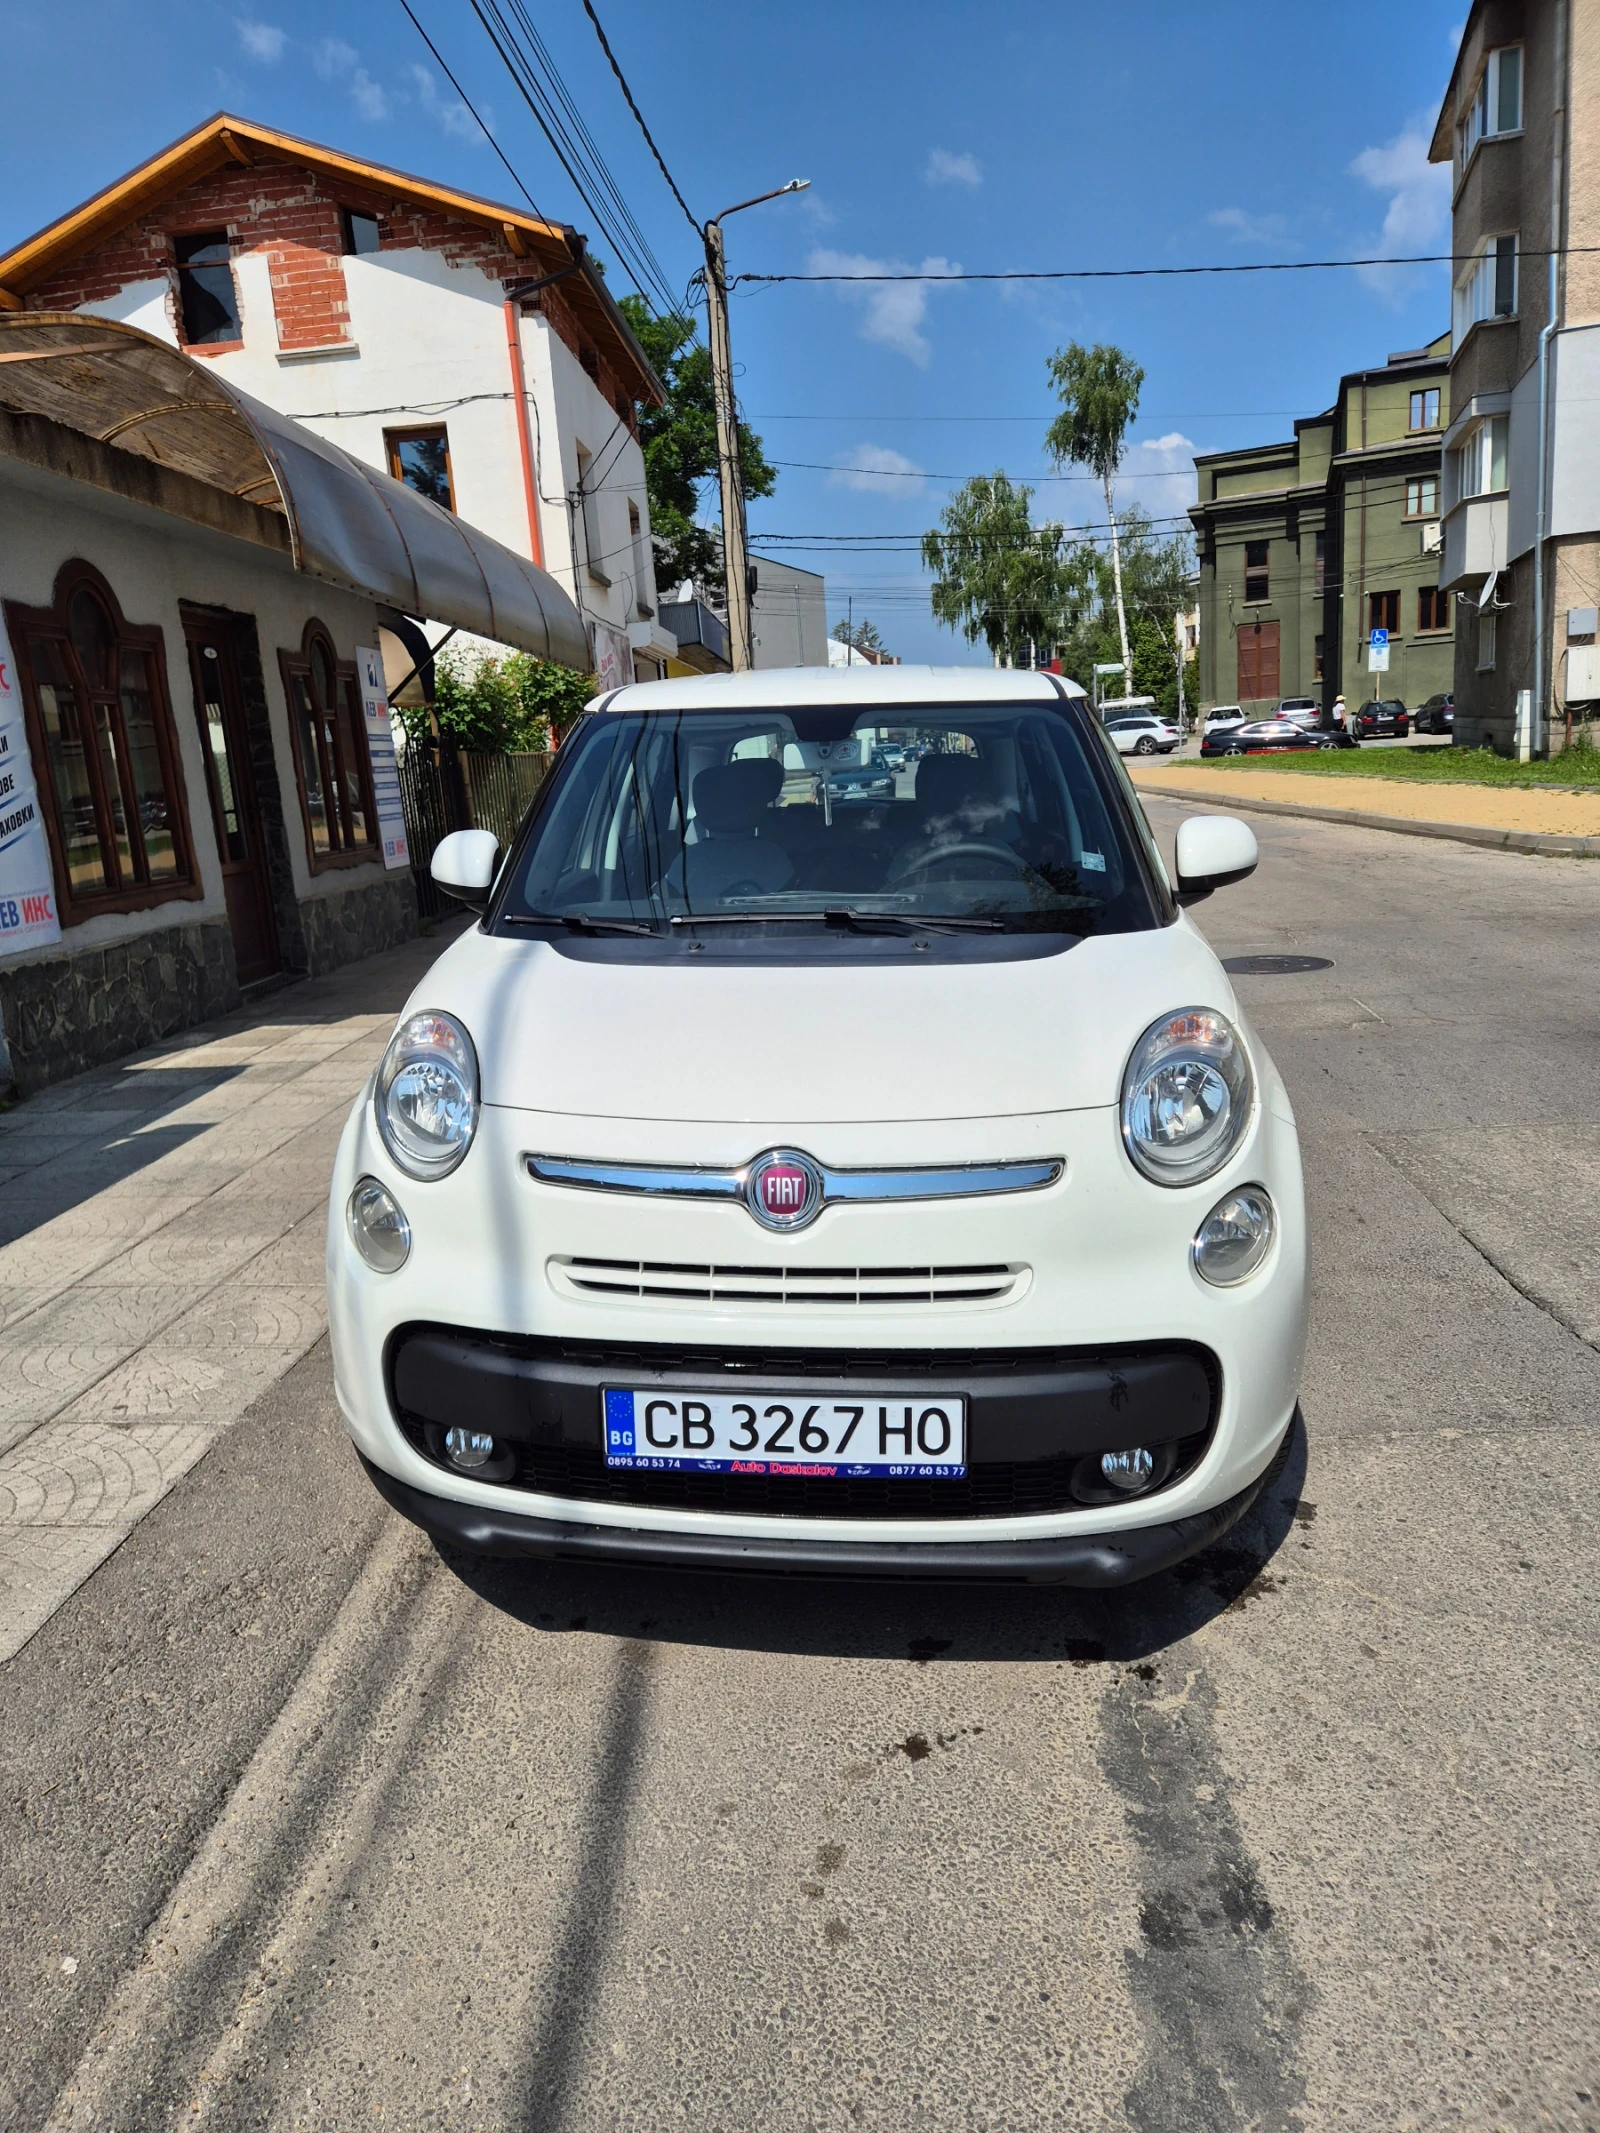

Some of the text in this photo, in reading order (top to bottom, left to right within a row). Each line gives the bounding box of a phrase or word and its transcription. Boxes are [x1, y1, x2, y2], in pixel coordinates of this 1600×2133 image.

[0, 893, 54, 929] ЕВ ИНС
[767, 1177, 802, 1205] FIAT
[645, 1400, 715, 1450] CB
[729, 1403, 864, 1454] 3267
[610, 1430, 633, 1446] BG
[607, 1457, 680, 1469] 0895 60 53 74
[731, 1460, 837, 1476] Auto Daskalov
[889, 1466, 965, 1476] 0877 60 53 77
